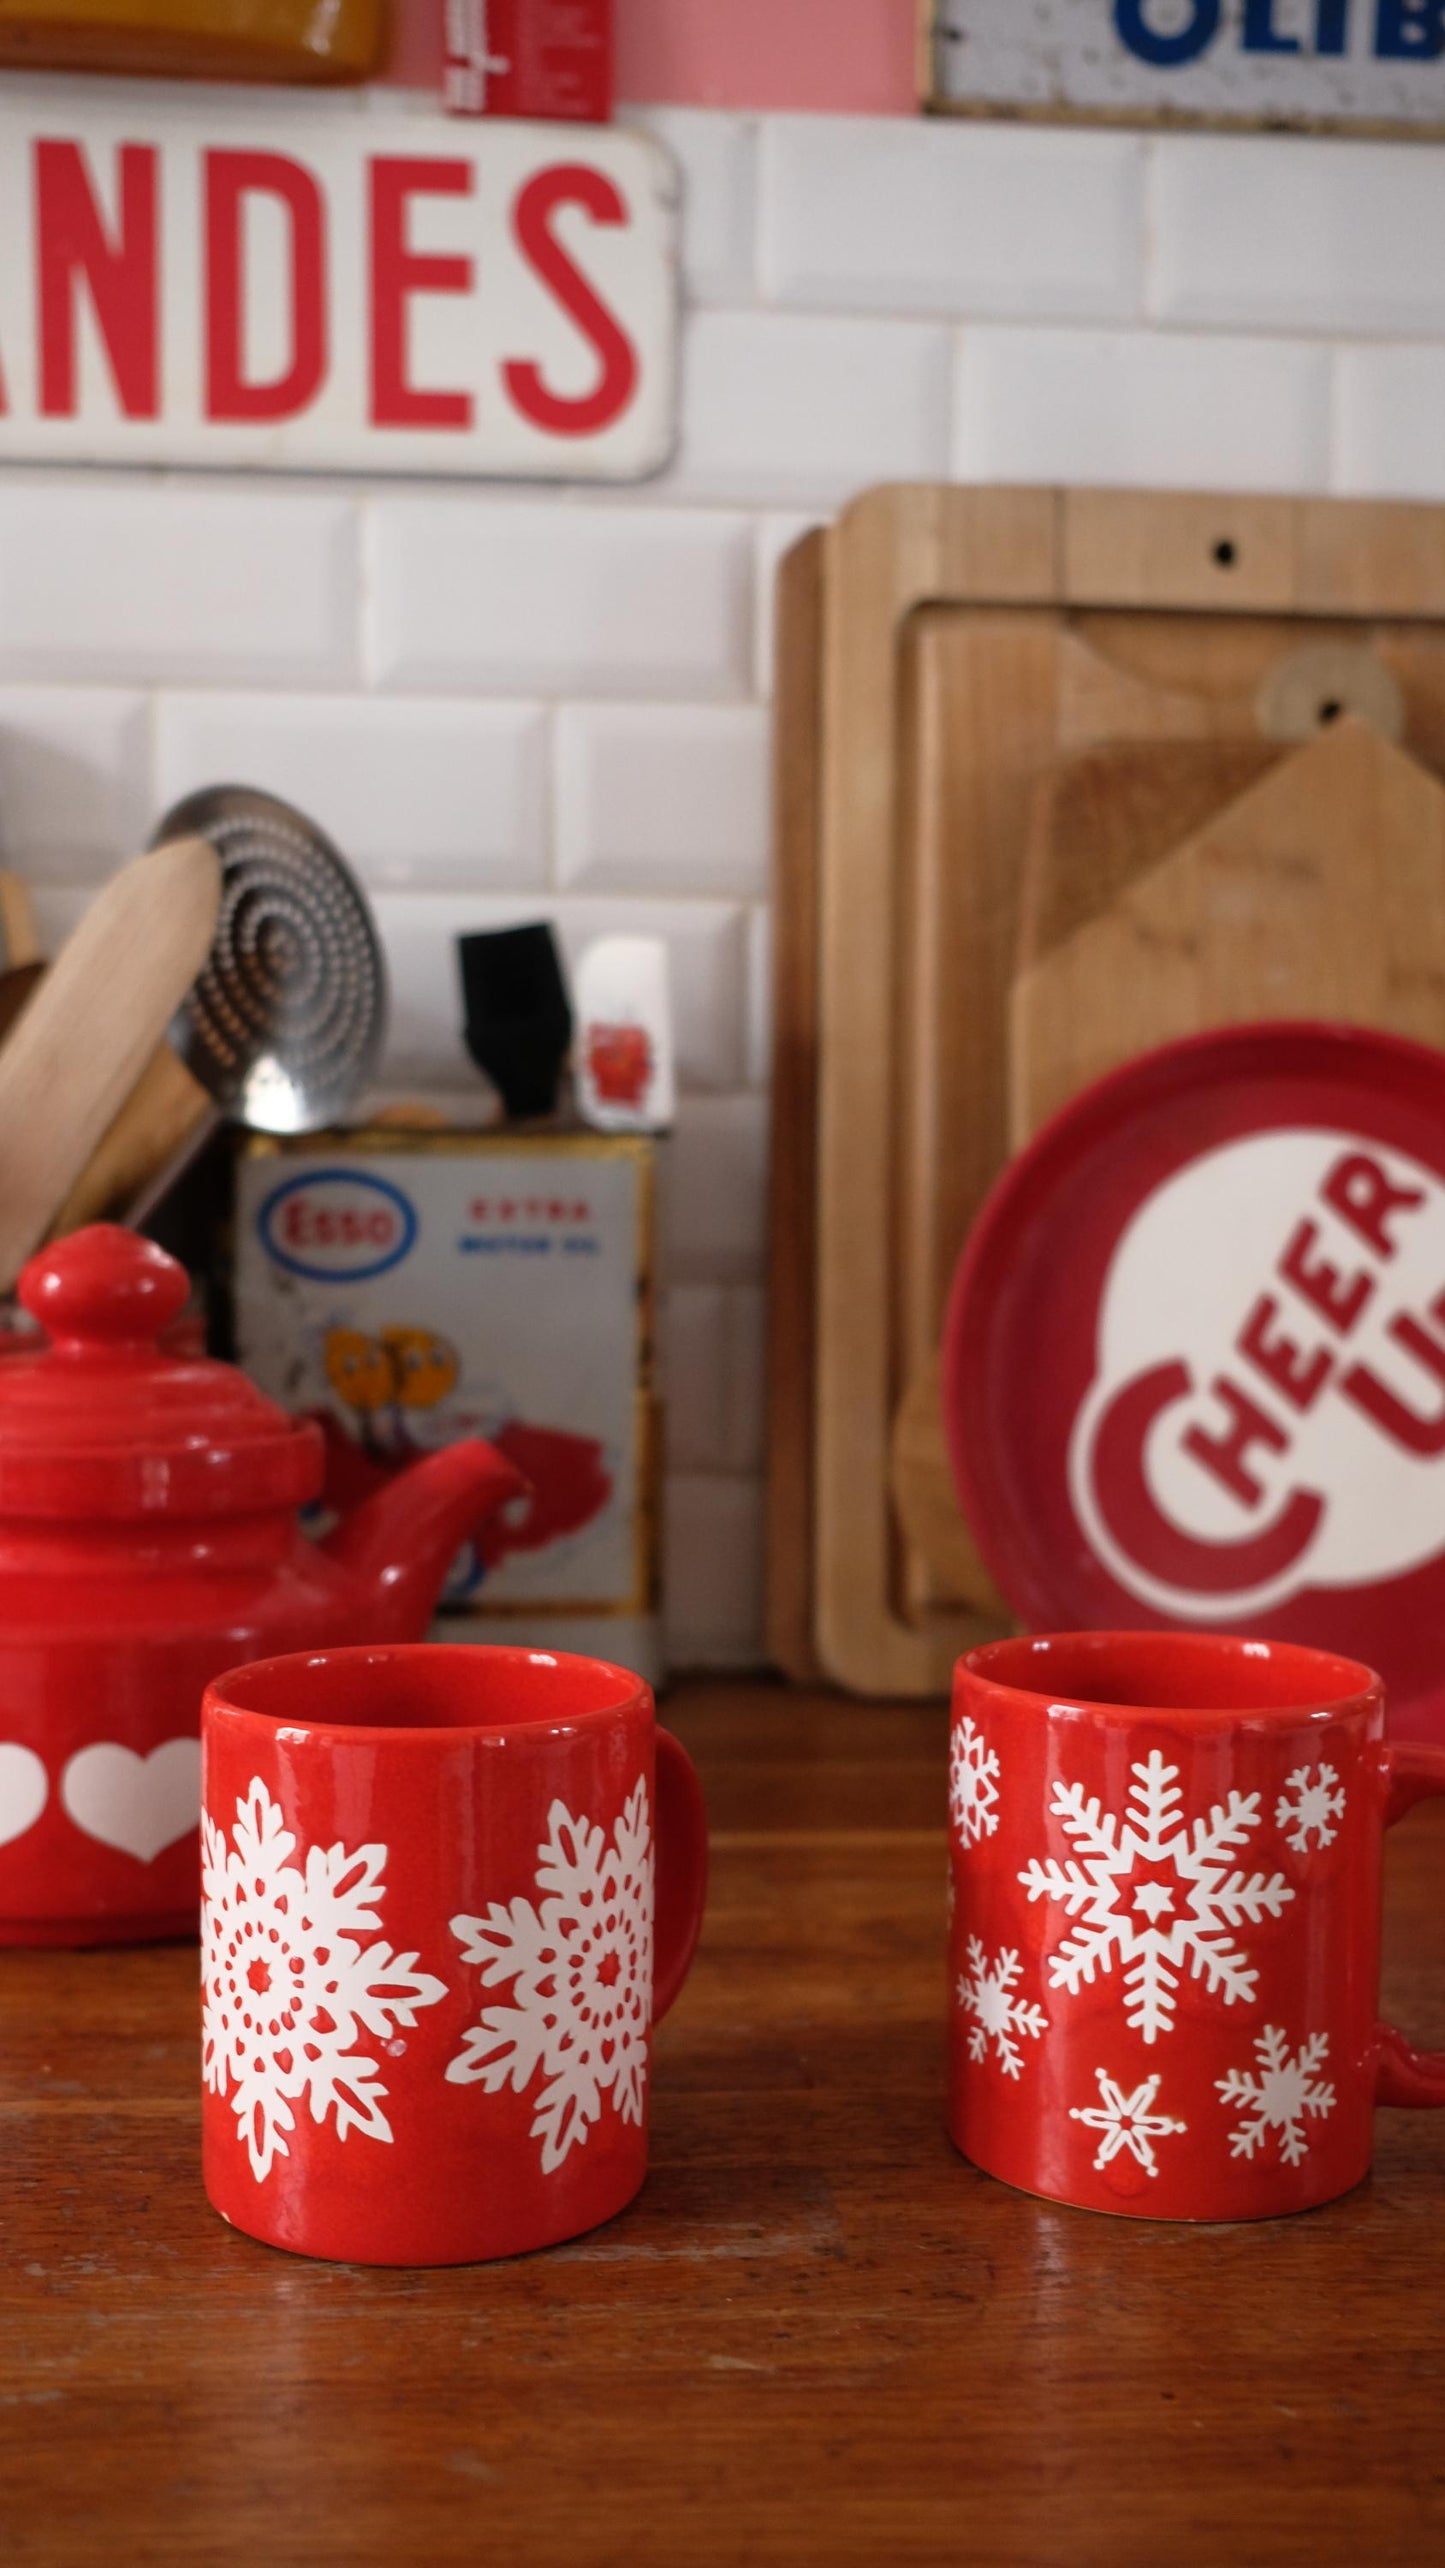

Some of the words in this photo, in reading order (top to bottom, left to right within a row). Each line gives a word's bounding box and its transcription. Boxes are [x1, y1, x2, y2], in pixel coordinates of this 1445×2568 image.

[0, 136, 640, 438] NDES
[469, 1196, 589, 1222] EXTRA
[1090, 1149, 1425, 1593] CHEER
[1340, 1287, 1445, 1462] U
